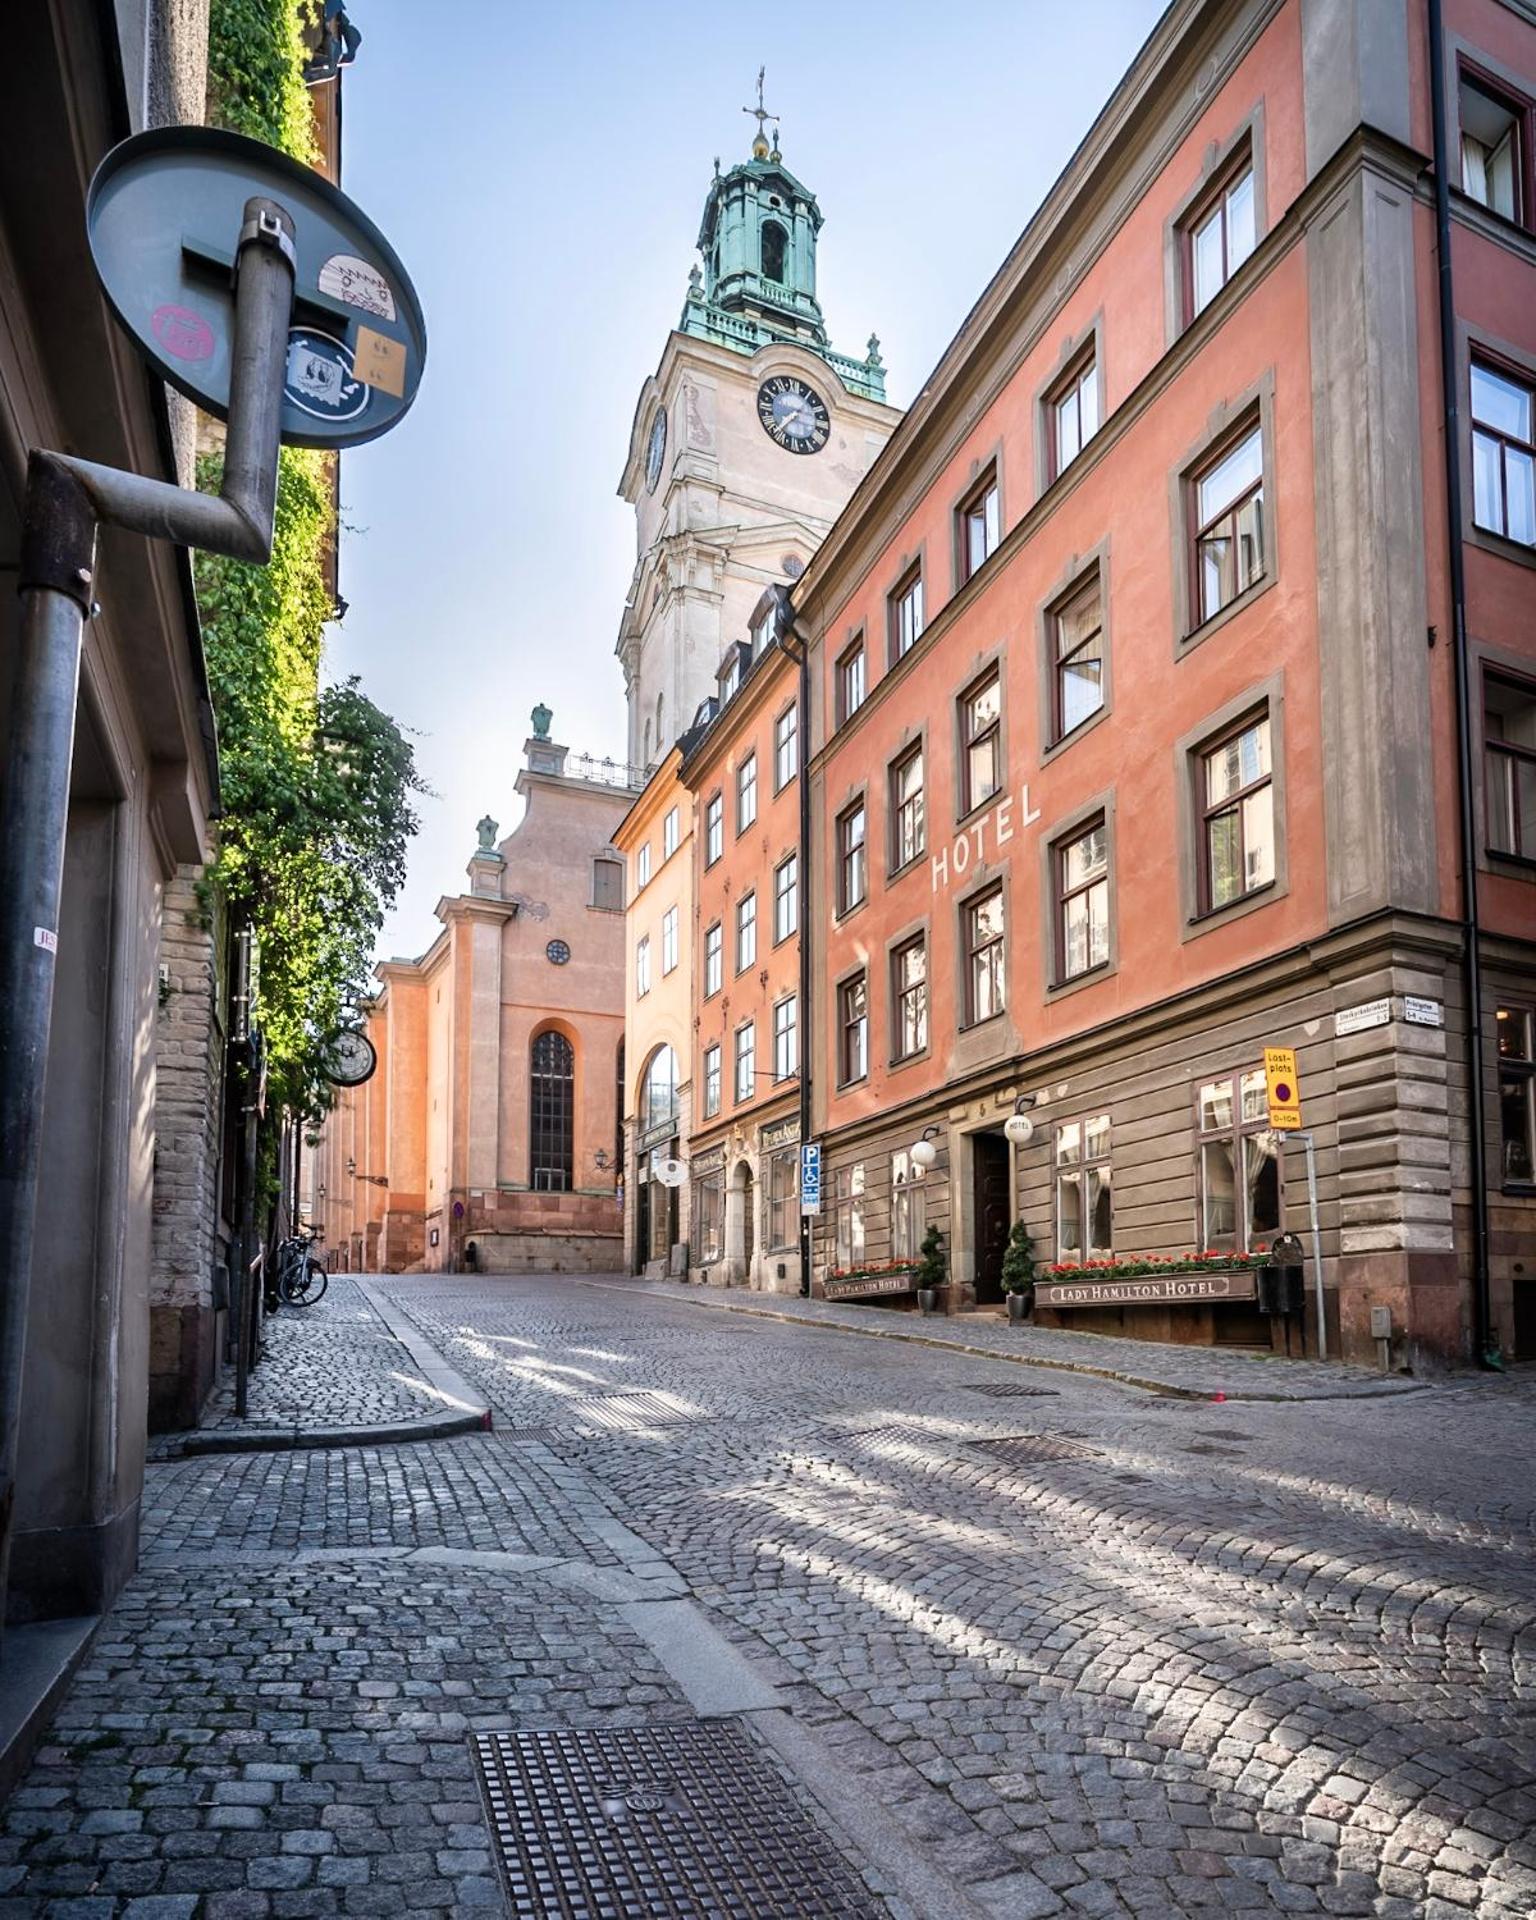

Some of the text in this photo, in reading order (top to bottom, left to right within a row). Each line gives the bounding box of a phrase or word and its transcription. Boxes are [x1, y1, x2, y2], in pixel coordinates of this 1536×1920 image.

[932, 784, 1041, 892] HOTEL
[1268, 1053, 1291, 1062] Last-
[1270, 1064, 1292, 1073] plats
[806, 1147, 817, 1163] P
[1060, 1281, 1215, 1300] LADY HAMILTON HOTEL
